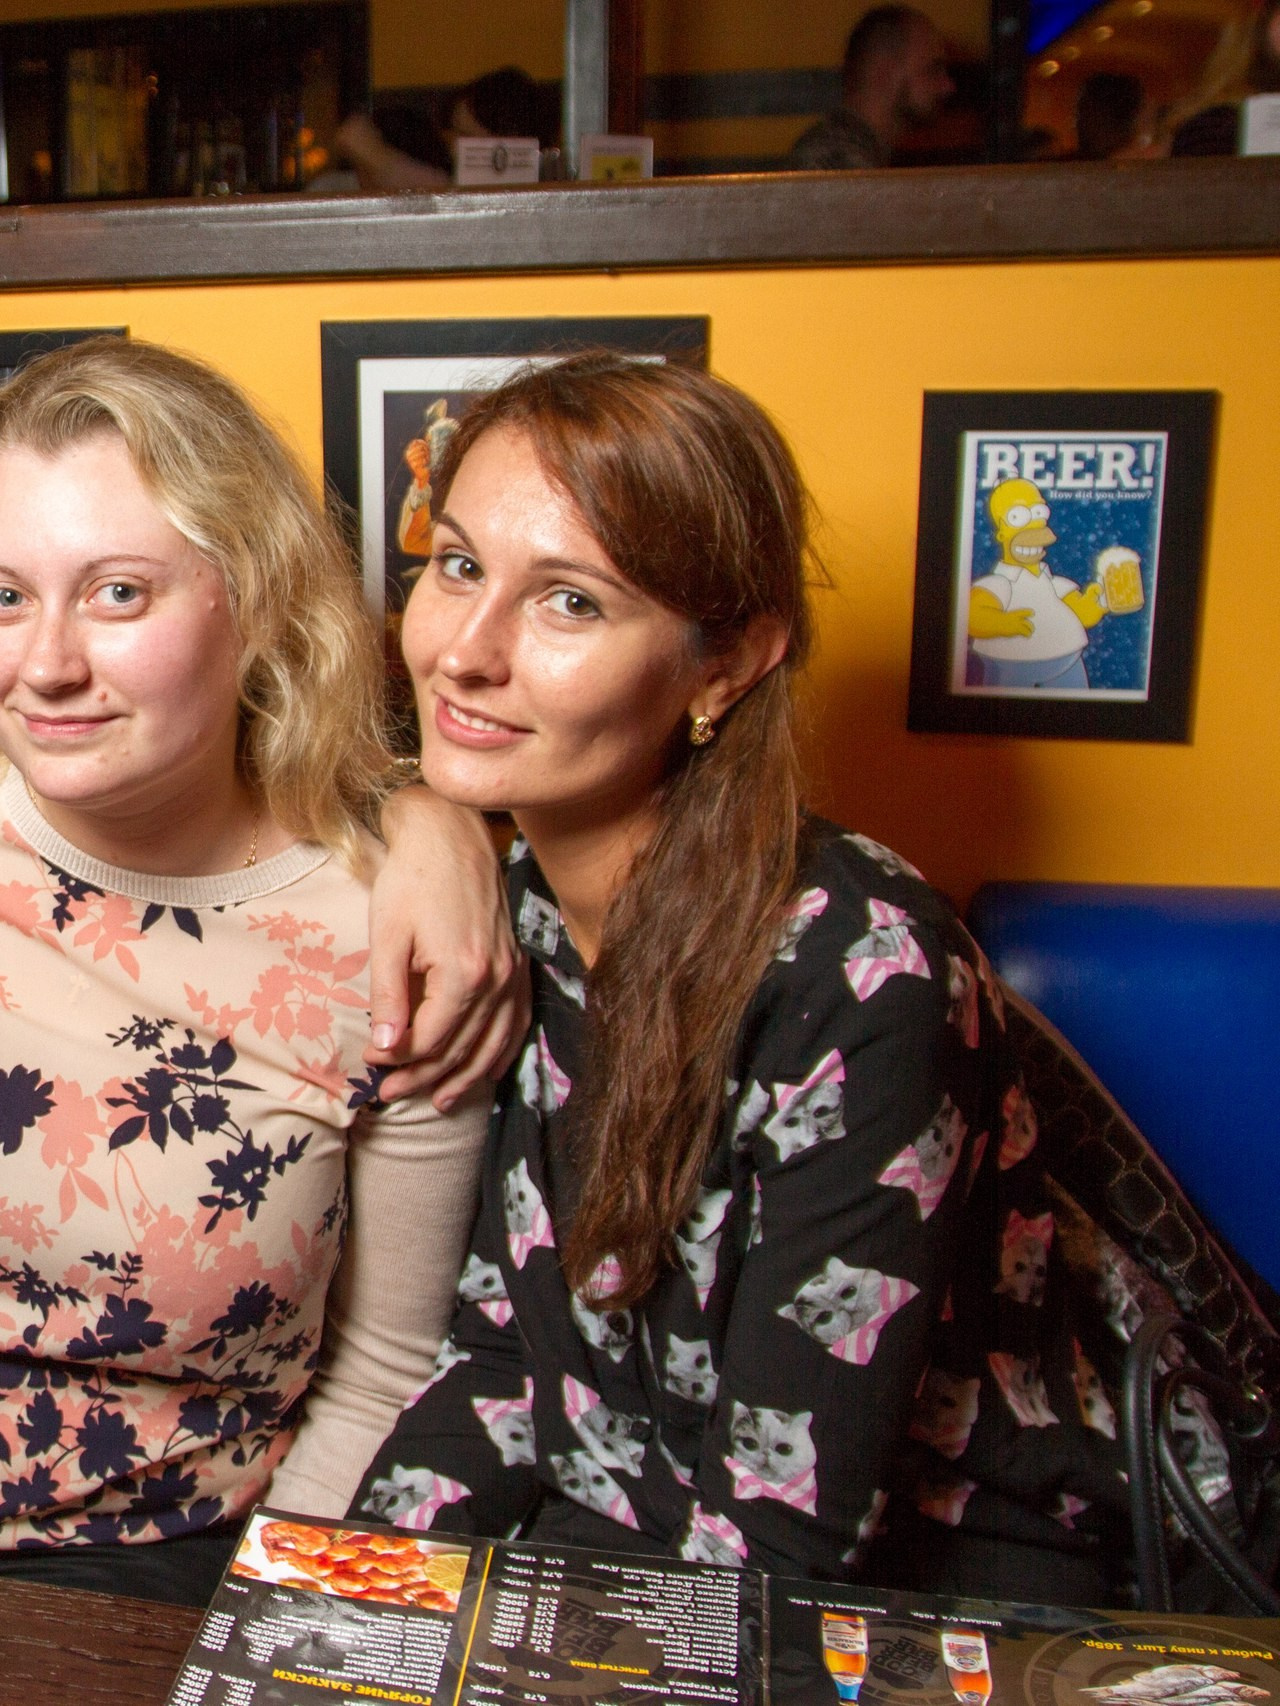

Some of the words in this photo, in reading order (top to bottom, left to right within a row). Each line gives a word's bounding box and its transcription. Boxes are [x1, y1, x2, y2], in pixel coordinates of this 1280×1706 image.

[981, 443, 1156, 489] BEER!
[1051, 490, 1072, 500] How
[1075, 490, 1093, 500] did
[607, 1592, 639, 1601] Bianco
[642, 1597, 694, 1608] Lambrusco
[698, 1603, 738, 1612] Beatrice
[645, 1610, 694, 1621] Spumante
[697, 1616, 738, 1626] Beatrice
[673, 1620, 738, 1633] Шампанское
[666, 1633, 690, 1641] Розе
[677, 1628, 737, 1640] Российское
[363, 1641, 402, 1652] закуска
[693, 1636, 737, 1647] Мартини
[1081, 1639, 1124, 1651] 165р.
[404, 1648, 444, 1659] Горячая
[663, 1647, 689, 1655] Брют
[693, 1643, 737, 1654] Мартини
[1132, 1643, 1167, 1653] 1шт.
[1169, 1644, 1205, 1655] пиву
[664, 1654, 709, 1665] Мартини
[692, 1650, 737, 1661] Мартини
[1221, 1648, 1273, 1660] Рыбка
[405, 1655, 443, 1665] Крылья
[712, 1660, 737, 1669] Асти
[403, 1661, 441, 1672] Крылья
[664, 1662, 709, 1672] Мартини
[712, 1668, 736, 1676] Асти
[393, 1667, 440, 1679] Креветки
[528, 1671, 550, 1679] 0,75
[272, 1668, 353, 1693] ЗАКУСКИ
[392, 1674, 438, 1686] Креветки
[415, 1685, 436, 1693] Уши
[470, 1685, 504, 1695] 4450р.
[354, 1685, 432, 1705] ГОРЯЧИЕ
[524, 1693, 546, 1701] 0,75
